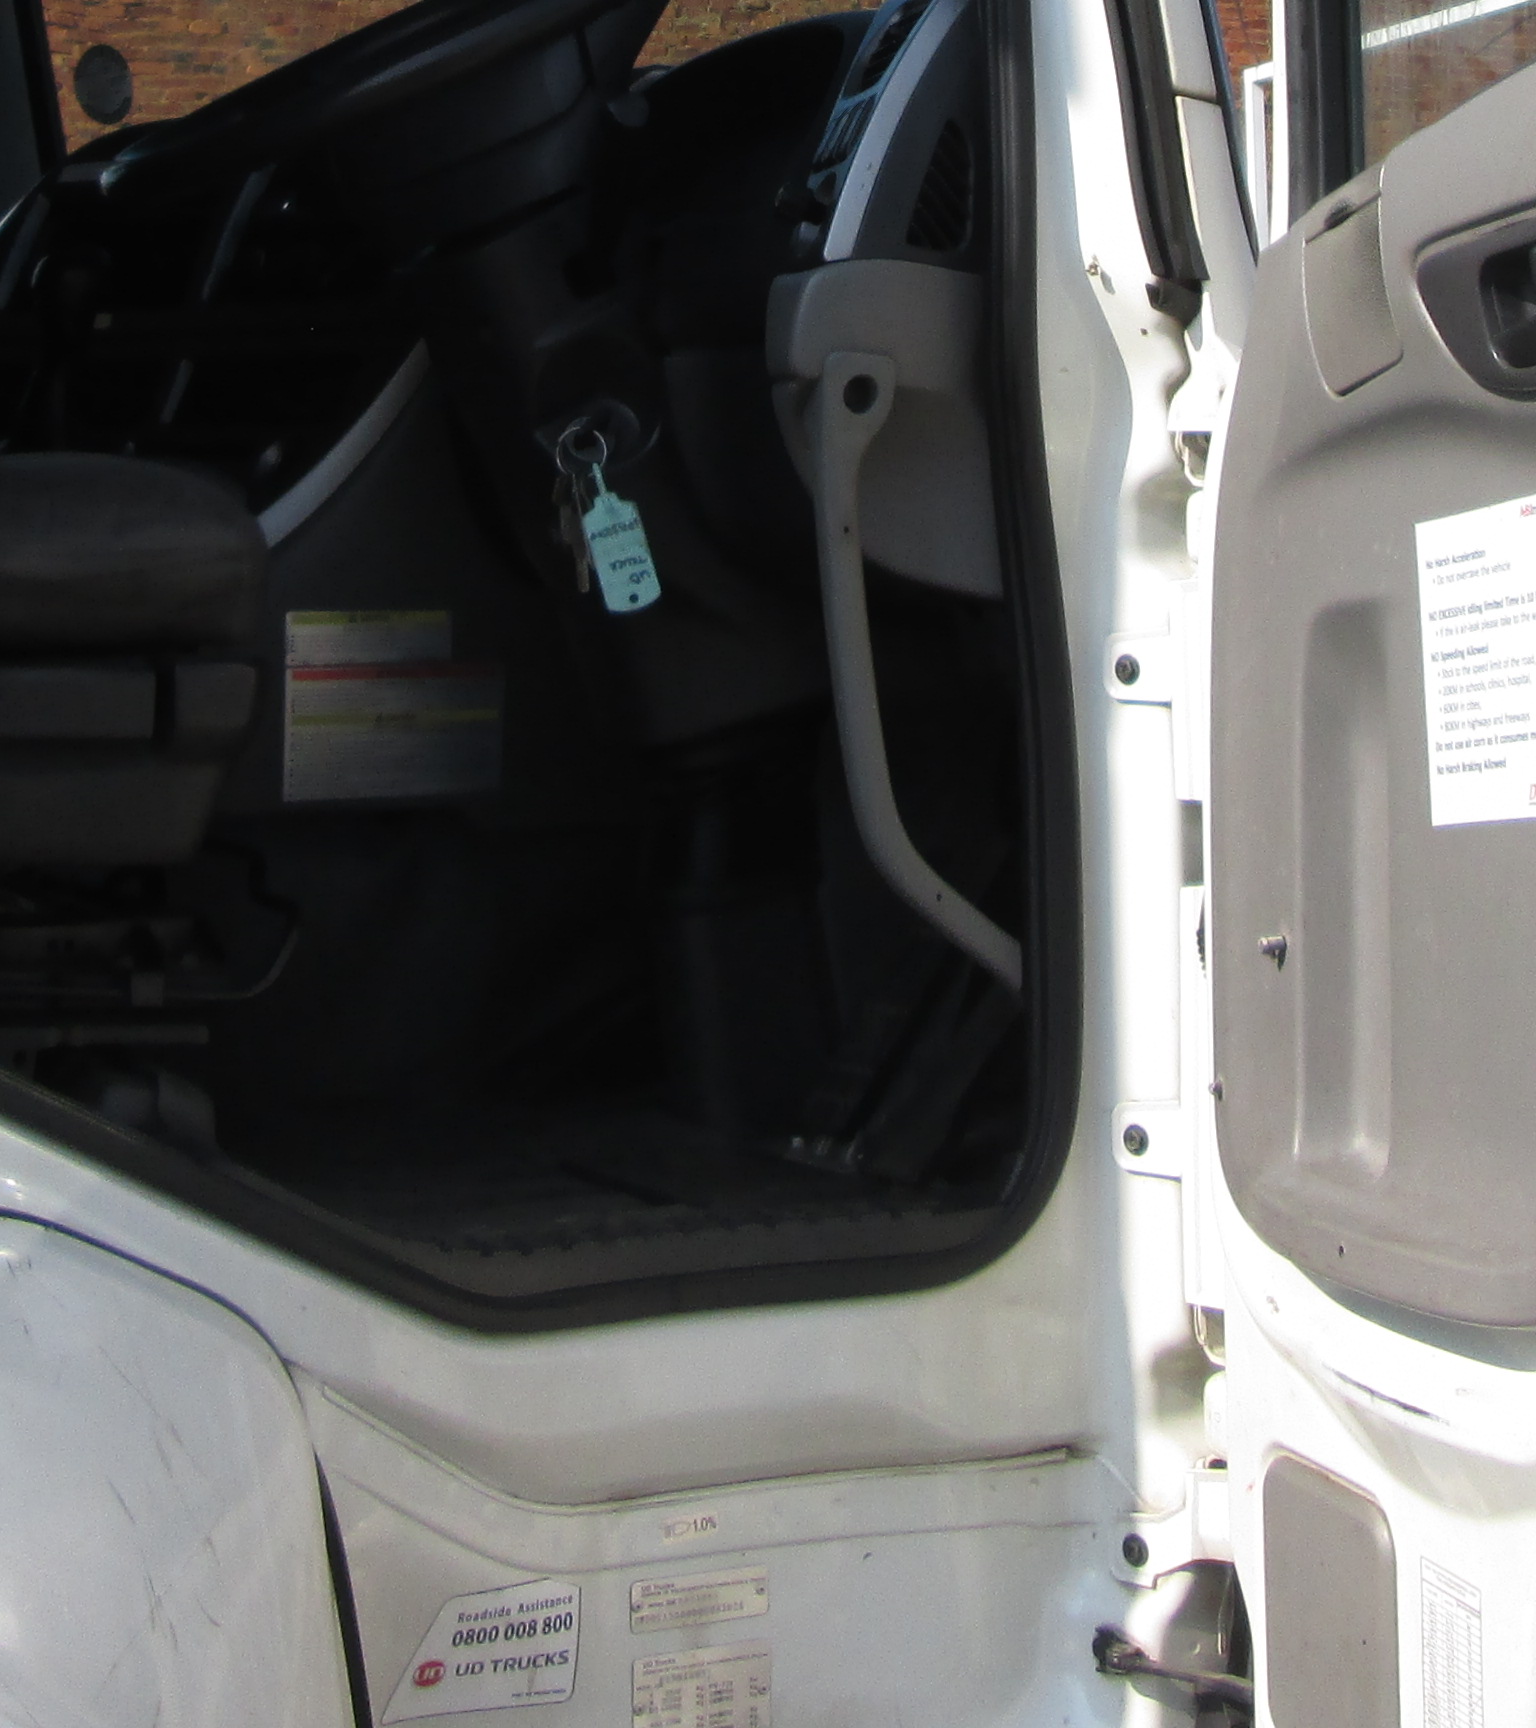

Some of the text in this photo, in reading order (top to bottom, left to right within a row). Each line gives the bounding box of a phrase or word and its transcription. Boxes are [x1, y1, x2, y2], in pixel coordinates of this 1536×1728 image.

[1435, 556, 1450, 568] Harsh
[1452, 549, 1486, 564] Acceleration
[1505, 596, 1519, 606] Time
[1440, 648, 1465, 663] Speeding
[1466, 643, 1489, 656] Allowed
[1472, 663, 1488, 674] speed
[1490, 660, 1502, 670] limit
[1500, 732, 1529, 744] consumes
[1445, 762, 1461, 774] Harsh
[1484, 757, 1506, 770] Allowed
[693, 1517, 717, 1532] 1.0%
[457, 1594, 574, 1624] Roadside Assistance
[452, 1612, 574, 1647] 0800 008 800
[455, 1649, 570, 1677] UD TRUCKS
